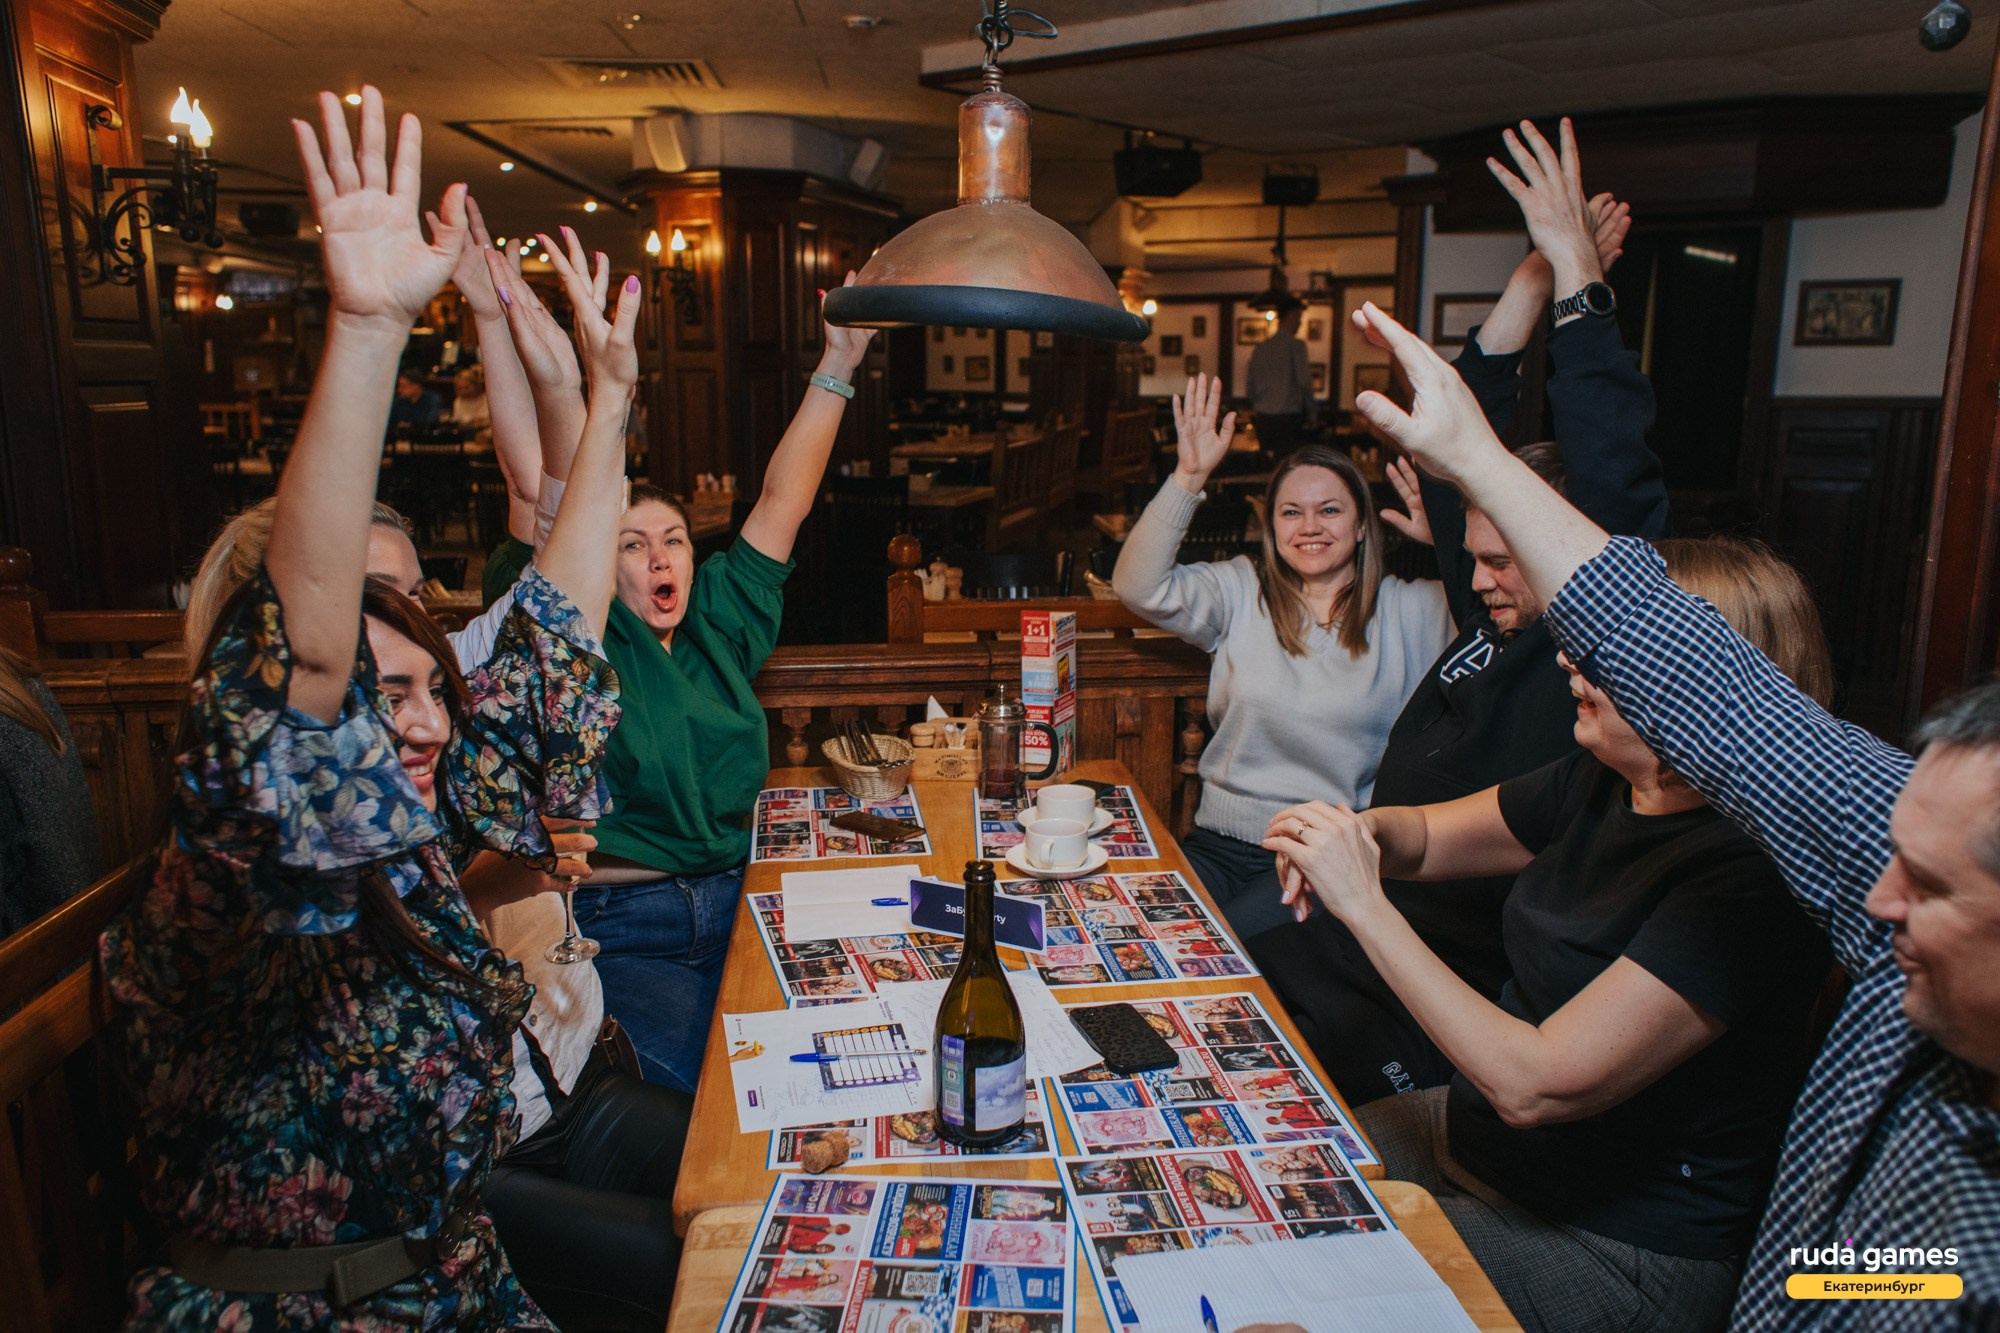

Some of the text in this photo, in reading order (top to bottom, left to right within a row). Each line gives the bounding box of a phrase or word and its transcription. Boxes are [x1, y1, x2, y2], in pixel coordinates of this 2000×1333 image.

[1027, 625, 1045, 636] 1+1
[1025, 736, 1048, 745] 50%
[1199, 1051, 1233, 1096] MAXIMILIANS.RU
[1158, 1155, 1185, 1191] ПОДАРОК
[945, 1185, 967, 1258] ИМЕНИННИКАМ
[1178, 1197, 1198, 1219] ЛАНЧ
